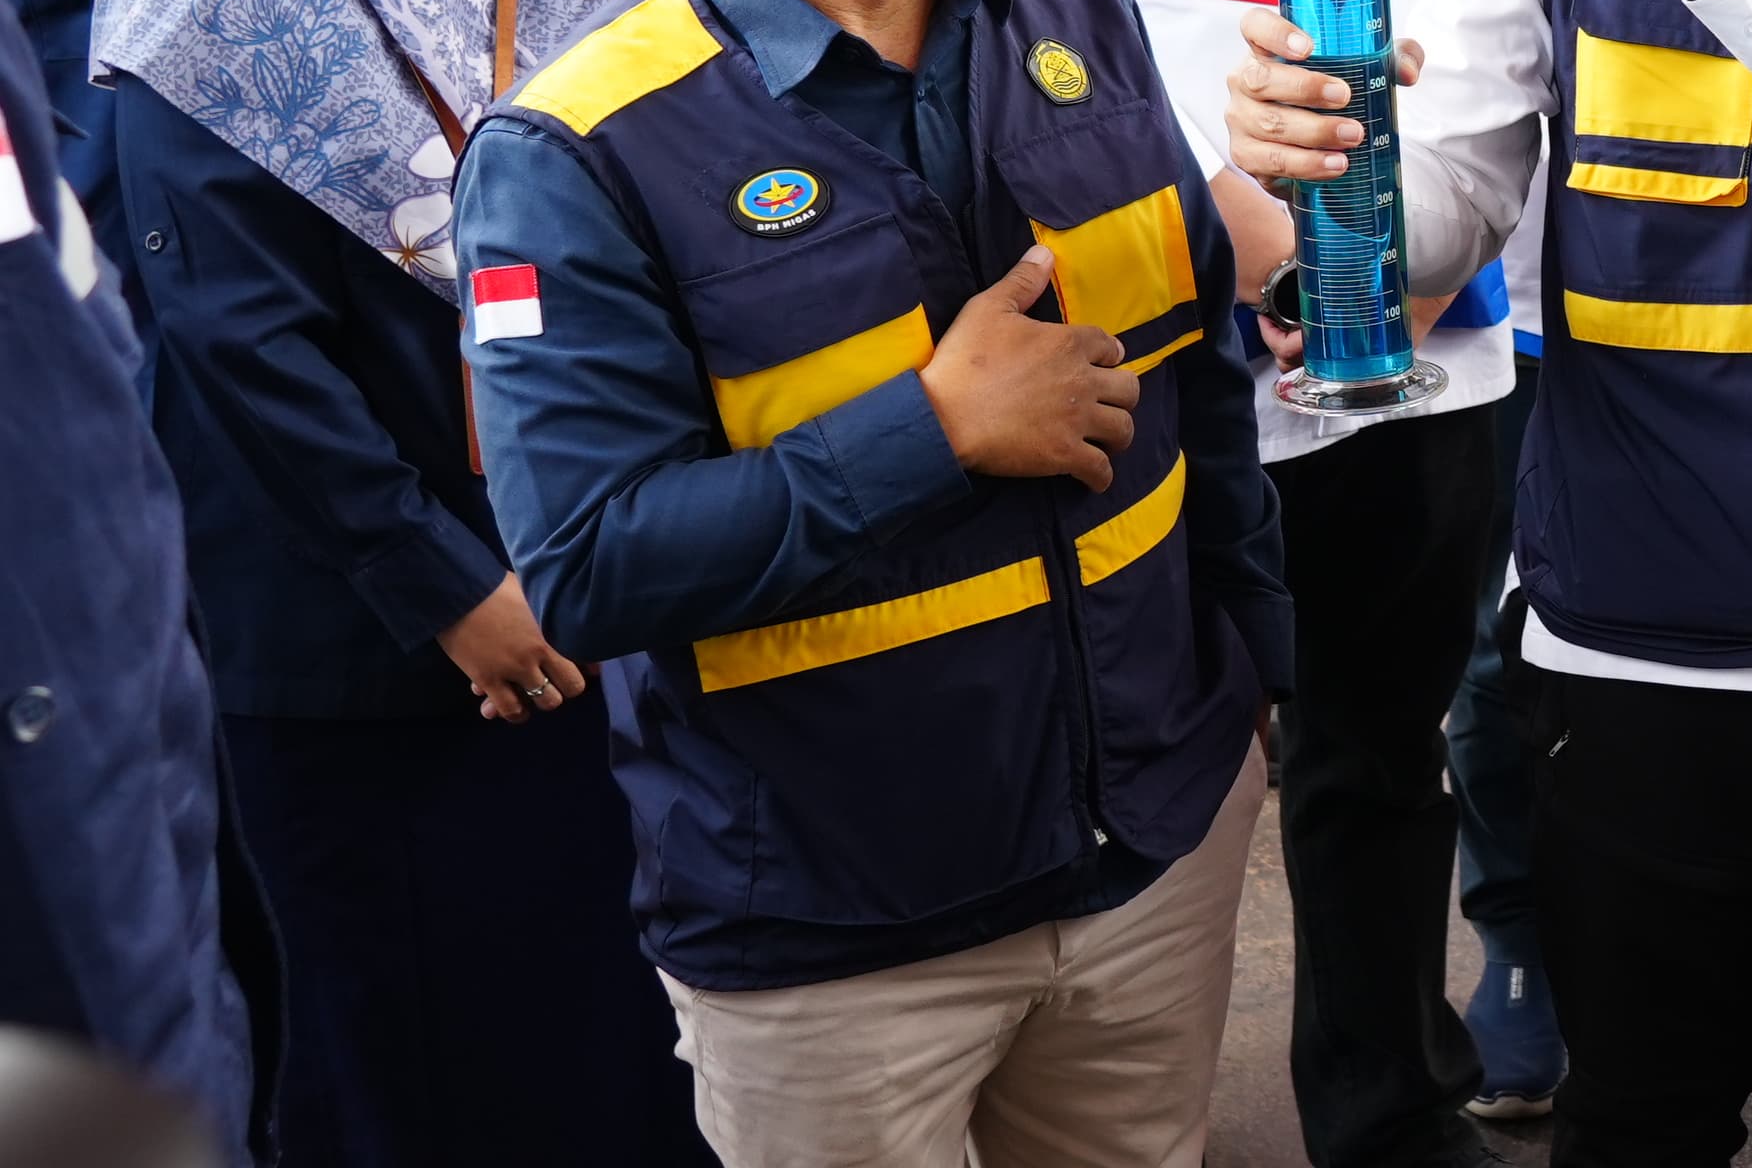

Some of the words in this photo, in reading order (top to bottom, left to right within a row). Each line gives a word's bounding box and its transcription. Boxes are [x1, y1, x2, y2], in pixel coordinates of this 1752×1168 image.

[1365, 18, 1383, 31] 600
[1369, 76, 1387, 90] 500
[1373, 134, 1391, 148] 400
[1376, 191, 1394, 206] 300
[757, 223, 780, 231] BPH
[782, 209, 817, 228] MIGAS
[1380, 248, 1398, 263] 200
[1384, 305, 1401, 319] 100
